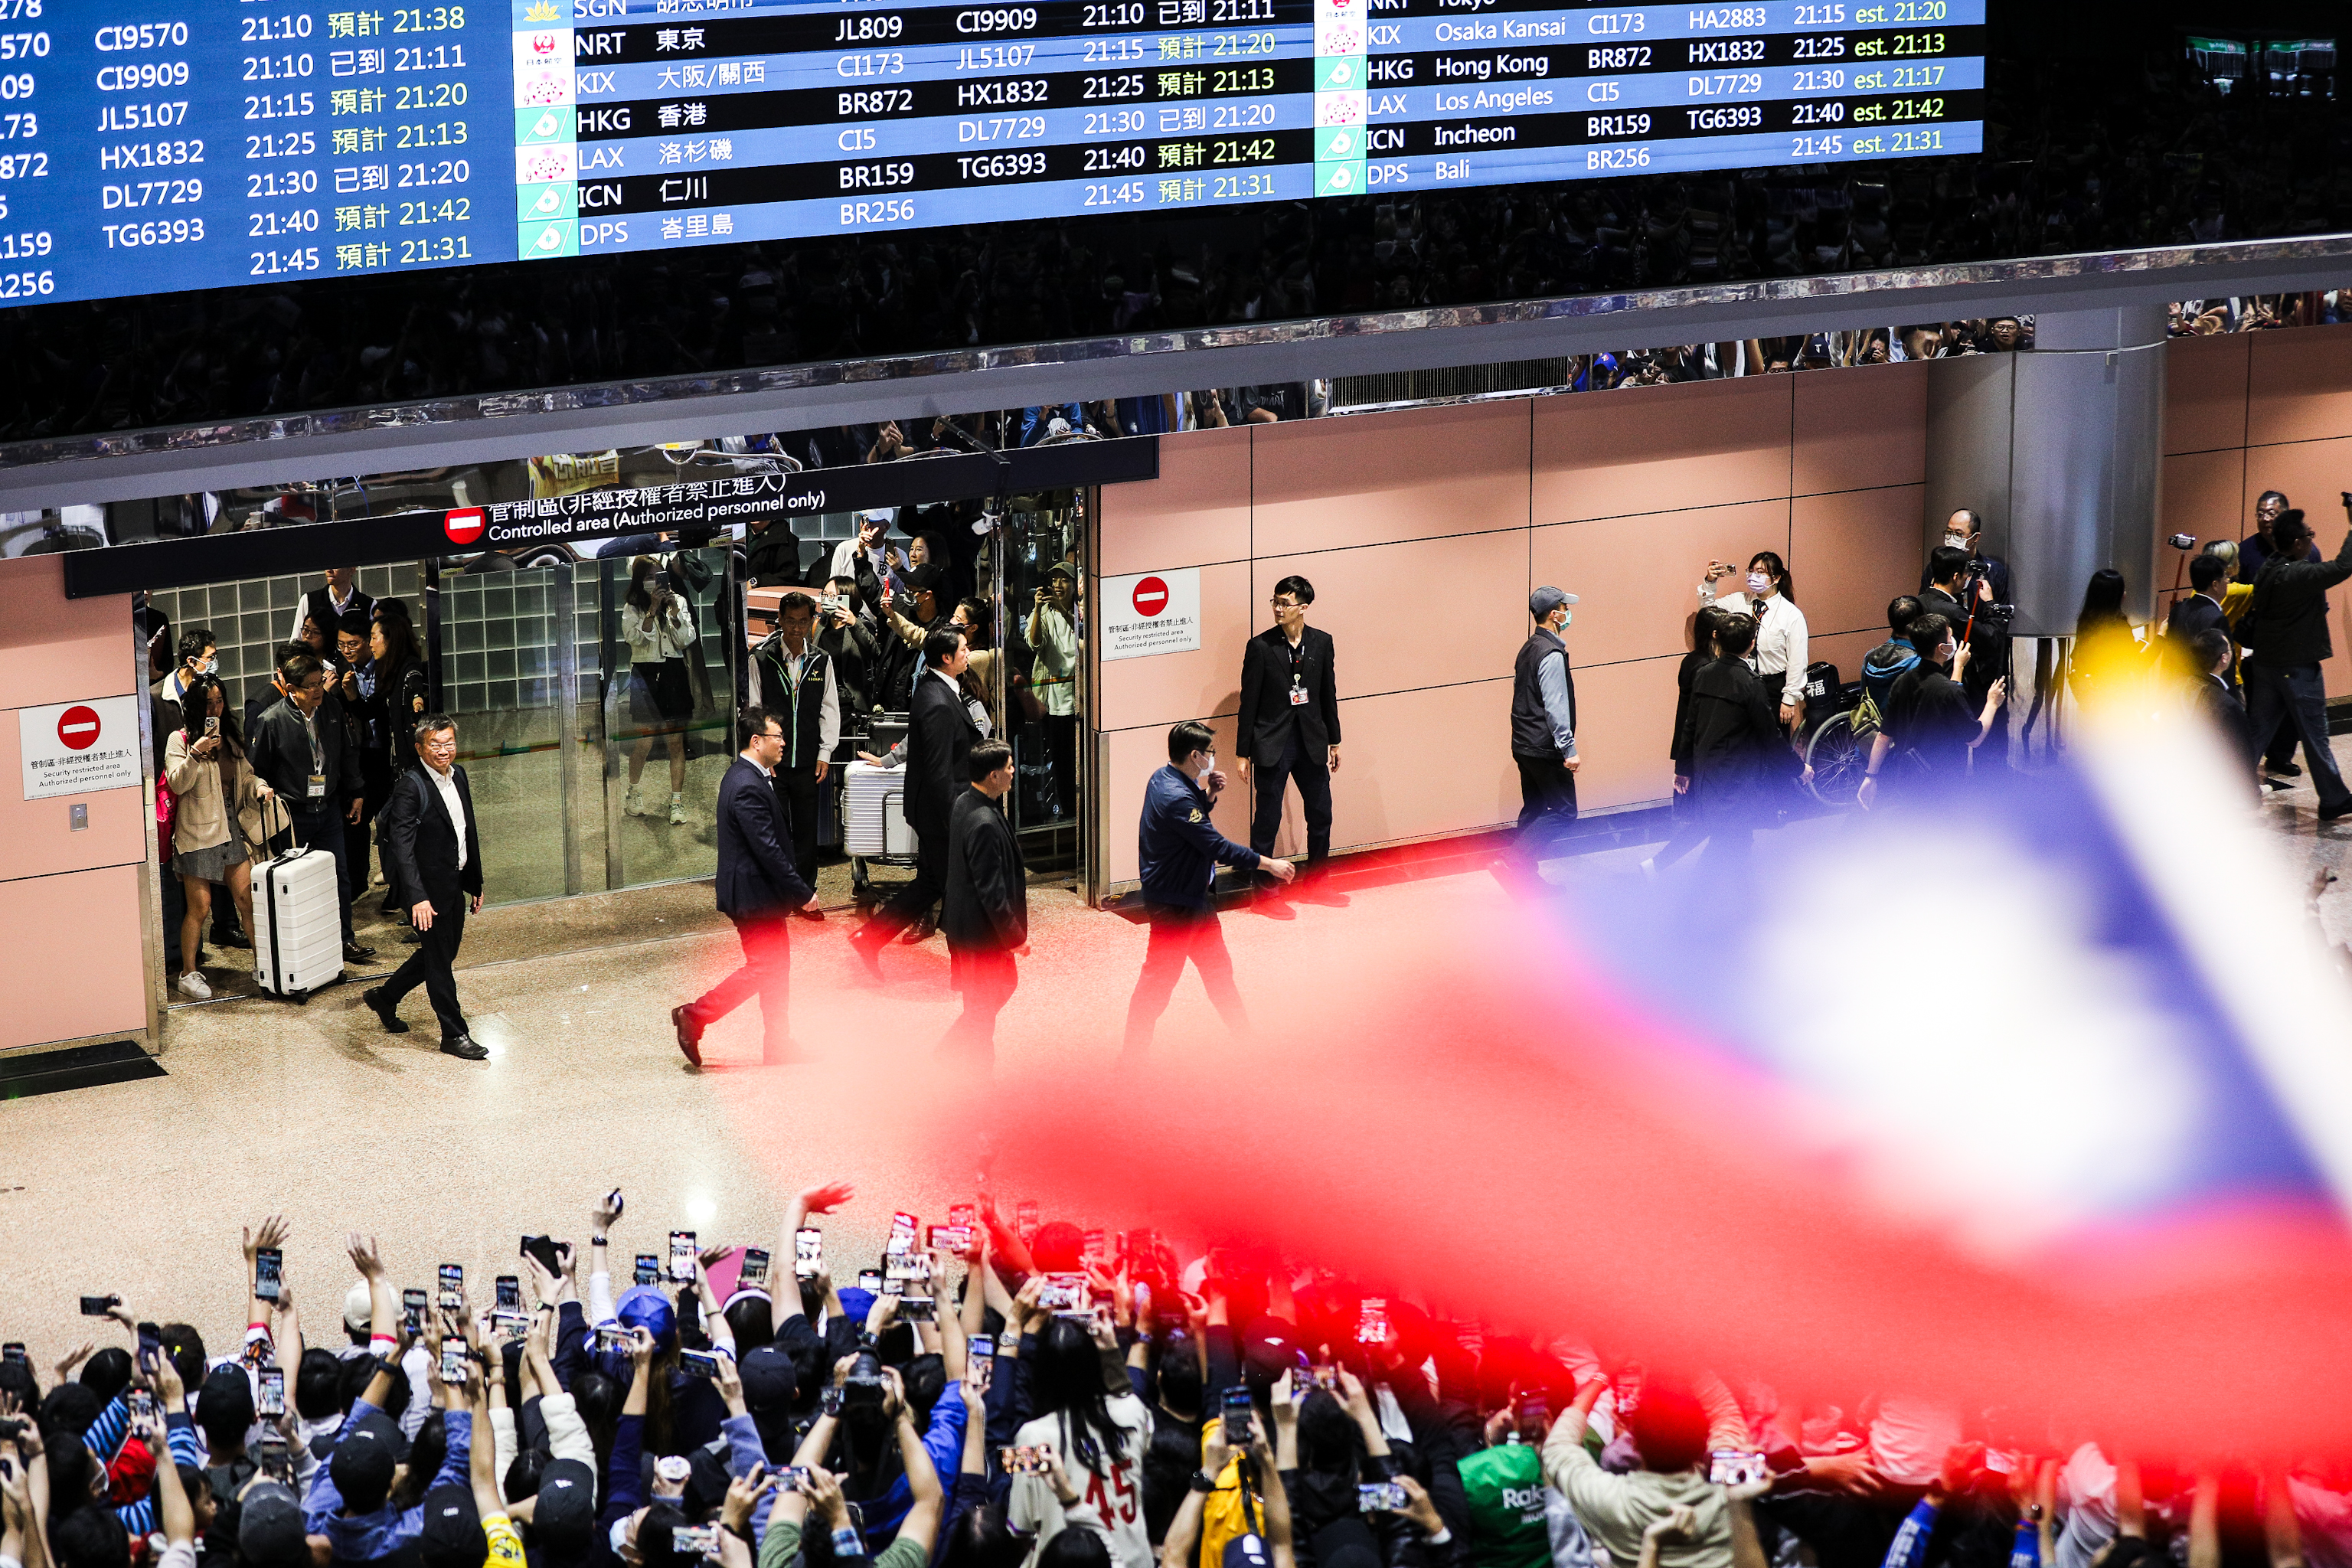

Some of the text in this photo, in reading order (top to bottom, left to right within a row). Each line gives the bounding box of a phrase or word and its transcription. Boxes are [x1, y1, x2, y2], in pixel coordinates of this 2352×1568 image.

[96, 22, 188, 51] CI9570
[242, 15, 312, 41] 21:10
[328, 11, 384, 38] 預計
[394, 7, 464, 32] 21:38
[577, 0, 1274, 55] NRT 東京 JL809 CI9909 21:10 已到 21:11
[1368, 2, 1945, 45] KIX Osaka Kansai CI173 HA2883 21:15 est. 21:20
[97, 62, 188, 90] CI9909
[243, 54, 313, 80] 21:10
[330, 48, 384, 76] 已到
[395, 44, 466, 70] 21:11
[577, 33, 1274, 93] KIX 大阪/關西 CI173 JL5107 21:15 預計 21:20
[1368, 34, 1944, 80] HKG Hong Kong BR872 HX1832 21:25 est. 21:13
[0, 83, 467, 139] 73 JL5107 21:15 預計 21:20
[578, 69, 1273, 132] HKG 香港 BR872 HX1832 21:25 預計 21:13
[1368, 67, 1944, 115] LAX Los Angeles CI5 DL7729 21:30 est. 21:17
[102, 140, 204, 169] HX1832
[247, 132, 315, 158] 21:25
[332, 126, 387, 154] 預計
[397, 122, 467, 148] 21:13
[579, 104, 1275, 169] LAX 洛杉磯 CI5 DL7729 21:30 已到 21:20
[1367, 99, 1942, 149] ICN Incheon BR159 TG6393 21:40 est. 21:42
[578, 139, 1274, 207] ICN 仁川 BR159 TG6393 21:40 預計 21:42
[1368, 130, 1942, 185] DPS Bali BR256 21:45 est. 21:31
[103, 179, 202, 209] DL7729
[247, 170, 317, 197] 21:30
[334, 165, 388, 192] 已到
[398, 160, 469, 187] 21:20
[0, 198, 469, 259] 159 TG6393 21:40 預計 21:42
[581, 175, 1274, 245] DPS 峇里島 BR256 21:45 預計 21:31
[250, 248, 319, 275] 21:45
[336, 241, 391, 270] 預計
[401, 236, 471, 263] 21:31
[489, 490, 825, 541] Controlled area (Authorized personnel only)
[1115, 642, 1148, 651] Authorized
[1149, 639, 1178, 647] personnel
[1143, 630, 1170, 639] restricted
[1805, 679, 1826, 697] 福
[39, 778, 78, 788] Authorized
[80, 774, 115, 784] personnel
[44, 769, 71, 778] Security
[73, 765, 104, 775] restricted
